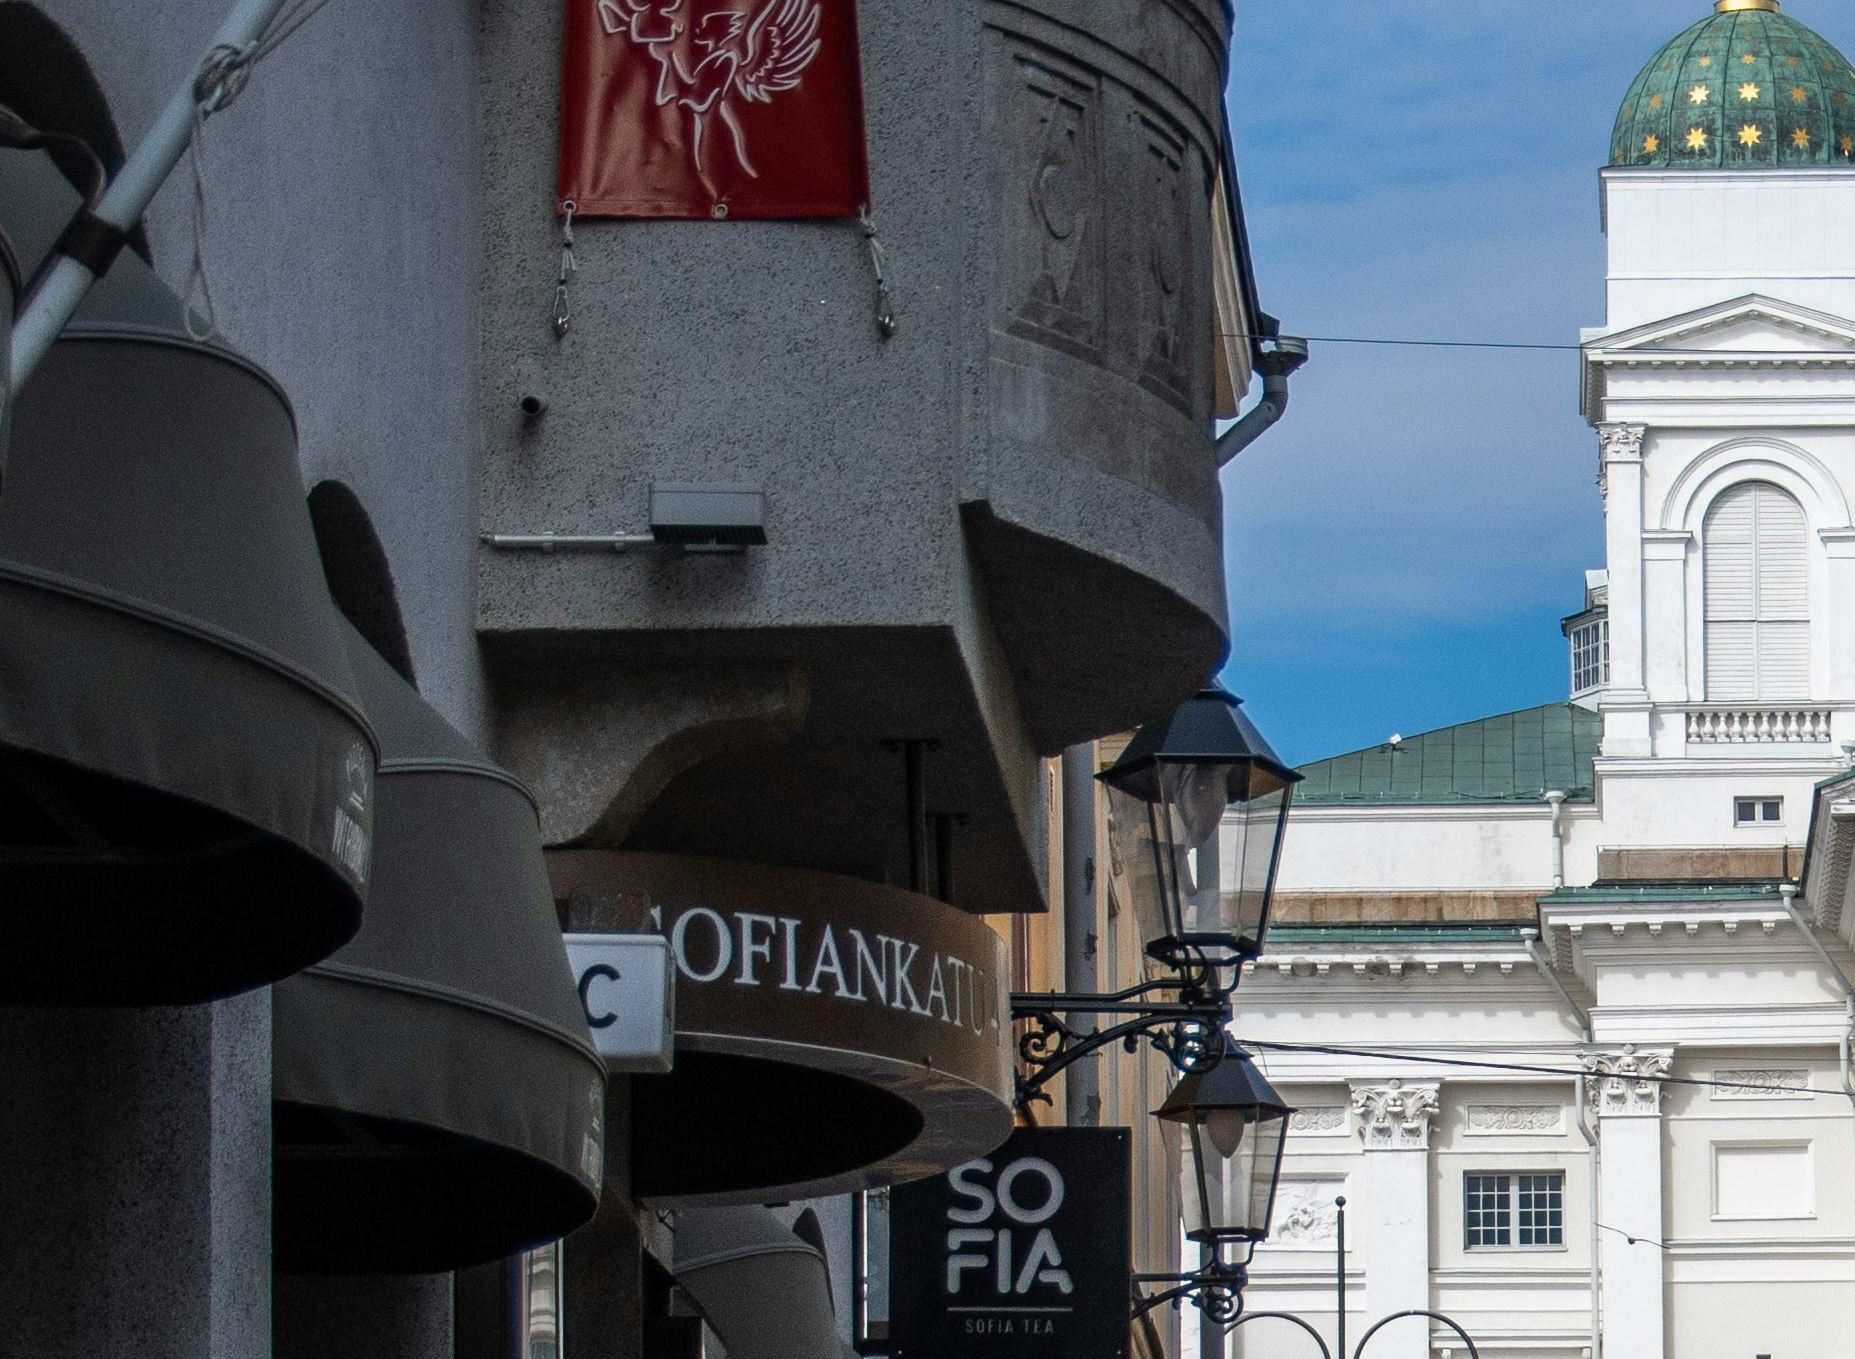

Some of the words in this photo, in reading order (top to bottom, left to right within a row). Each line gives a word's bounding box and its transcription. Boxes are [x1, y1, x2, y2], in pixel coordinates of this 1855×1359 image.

[651, 904, 985, 1036] OFIANKATU
[947, 1157, 1065, 1224] SO
[947, 1228, 1073, 1294] FIA
[965, 1318, 1013, 1333] SOFIA
[1024, 1318, 1053, 1333] TEA
